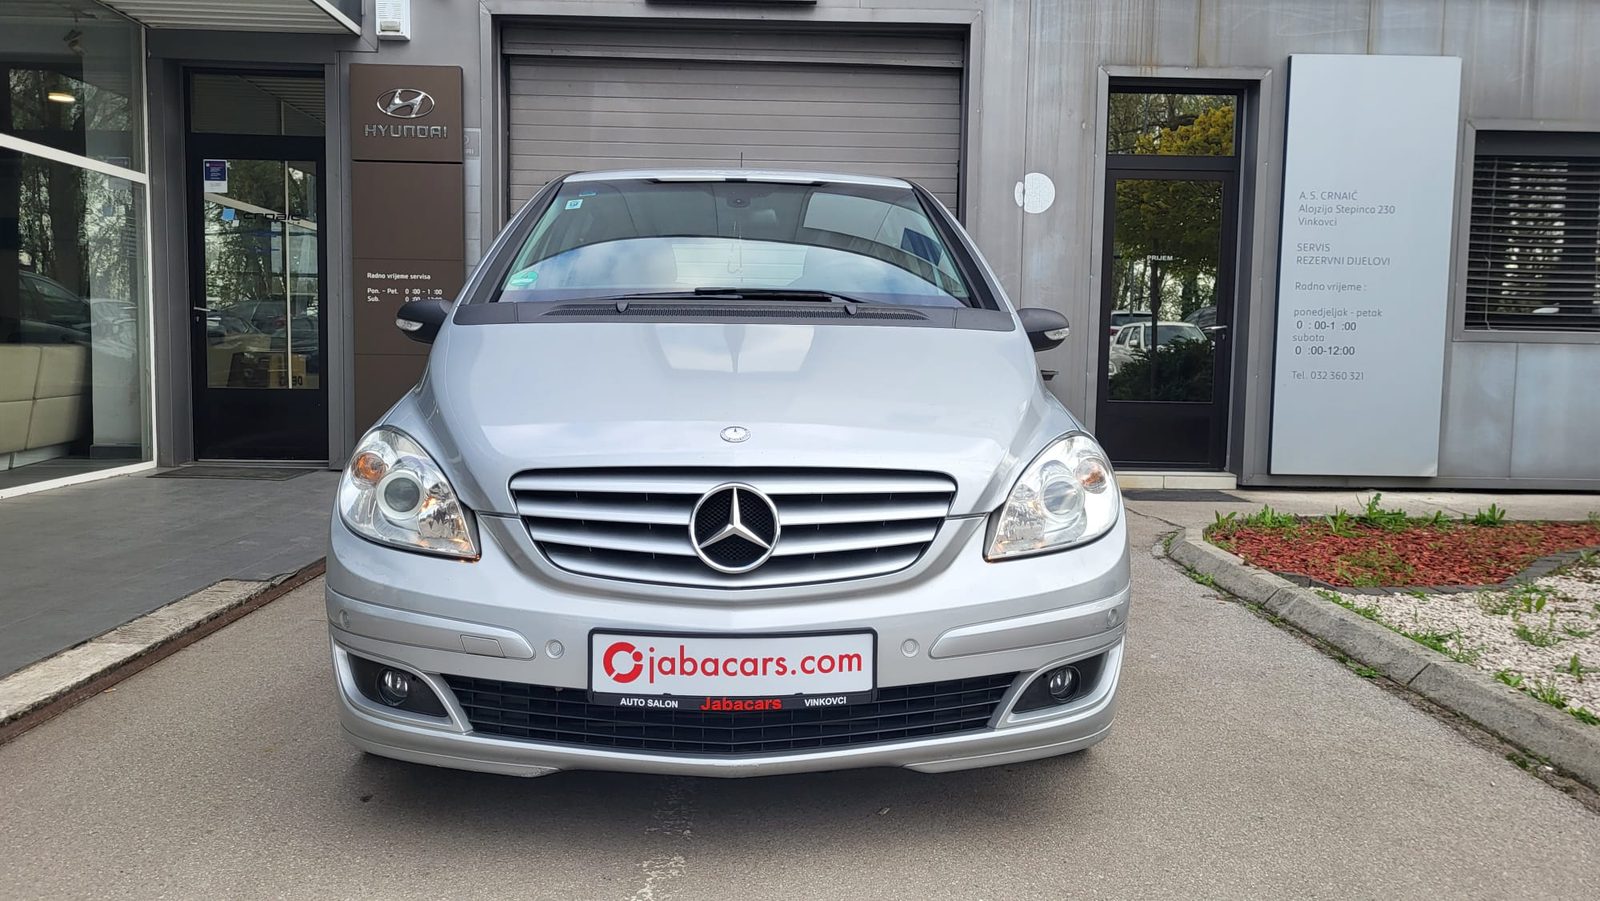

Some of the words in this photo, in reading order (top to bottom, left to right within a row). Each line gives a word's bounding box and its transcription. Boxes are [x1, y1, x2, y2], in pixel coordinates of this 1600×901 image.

[364, 124, 448, 138] HYUNDAI
[1320, 189, 1358, 200] CRNAIĆ
[1299, 204, 1333, 215] Alojzija
[1335, 204, 1376, 215] Stepinca
[1377, 205, 1396, 214] 230
[1298, 217, 1337, 226] Vinkovci
[1296, 242, 1331, 252] SERVIS
[1296, 256, 1345, 265] REZERVNI
[1346, 256, 1391, 266] DIJELOVI
[387, 272, 409, 281] vrijeme
[1295, 281, 1325, 291] Radno
[1327, 281, 1362, 293] vrijeme
[1294, 307, 1348, 319] ponedjeljak
[1356, 308, 1383, 319] petak
[1292, 333, 1325, 342] subota
[1310, 371, 1328, 380] 032
[1330, 371, 1348, 381] 360
[1350, 371, 1364, 381] 321
[649, 645, 863, 684] jabacars.com
[620, 697, 645, 707] AUTO
[647, 698, 678, 708] SALON
[700, 697, 782, 711] Jabacars
[804, 696, 847, 707] VINKOVCI
